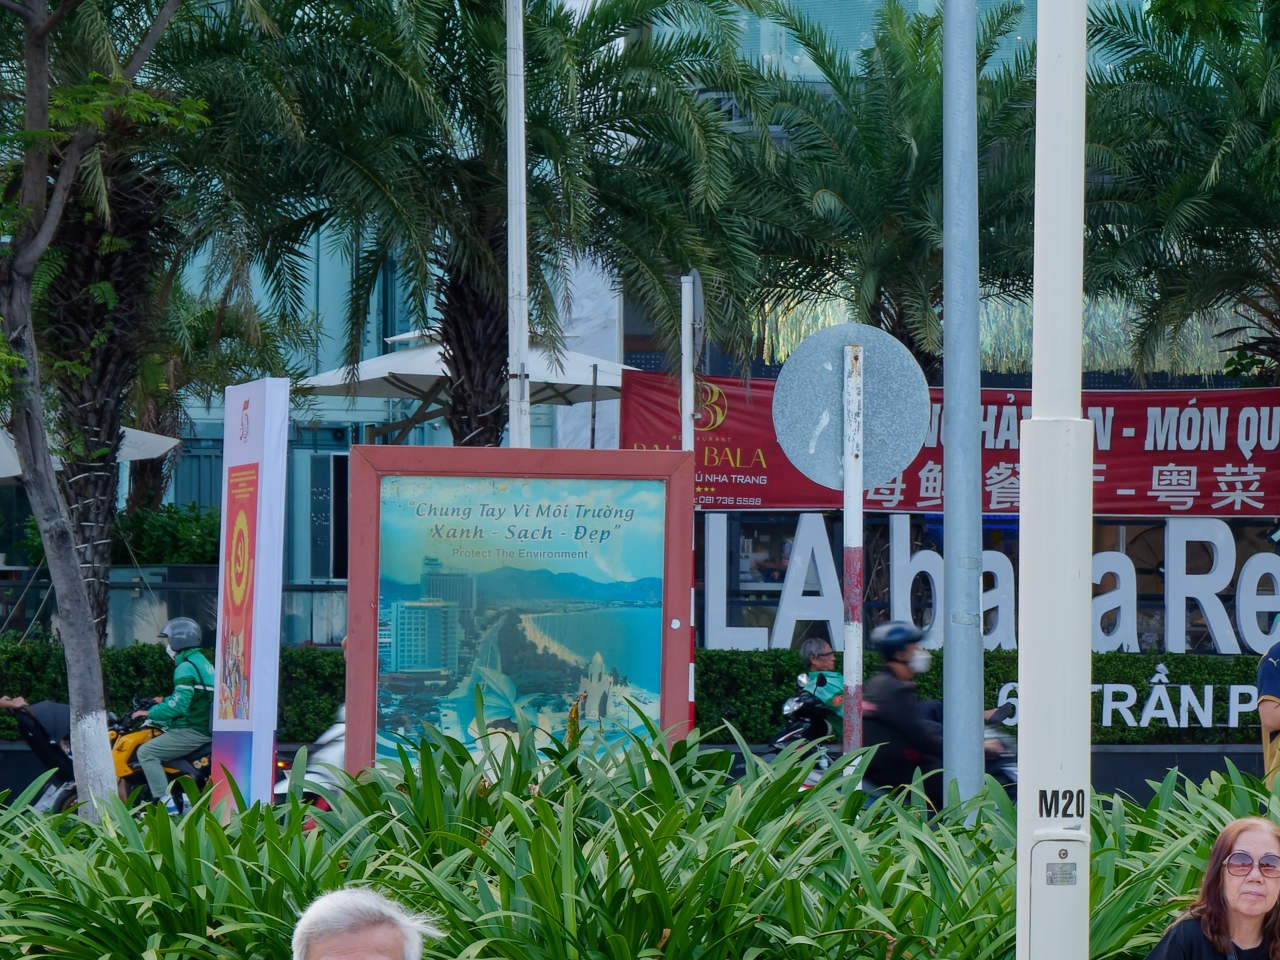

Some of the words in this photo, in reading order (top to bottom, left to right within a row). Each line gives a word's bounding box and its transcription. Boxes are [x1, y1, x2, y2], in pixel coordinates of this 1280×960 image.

[1144, 397, 1230, 451] MÓN
[704, 446, 767, 469] BALA
[705, 474, 729, 483] NHA
[731, 474, 768, 485] TRANG
[1147, 463, 1267, 510] 粤菜
[716, 496, 734, 505] 736
[480, 503, 506, 520] Tay
[513, 503, 530, 517] Vì
[536, 504, 569, 518] Môi
[575, 504, 635, 521] Trường
[431, 524, 484, 538] Xanh
[504, 524, 553, 543] Sạch
[452, 548, 492, 559] Protect
[495, 548, 513, 559] The
[518, 549, 589, 559] Environment
[889, 514, 1141, 653] baa
[1038, 789, 1085, 818] M20
